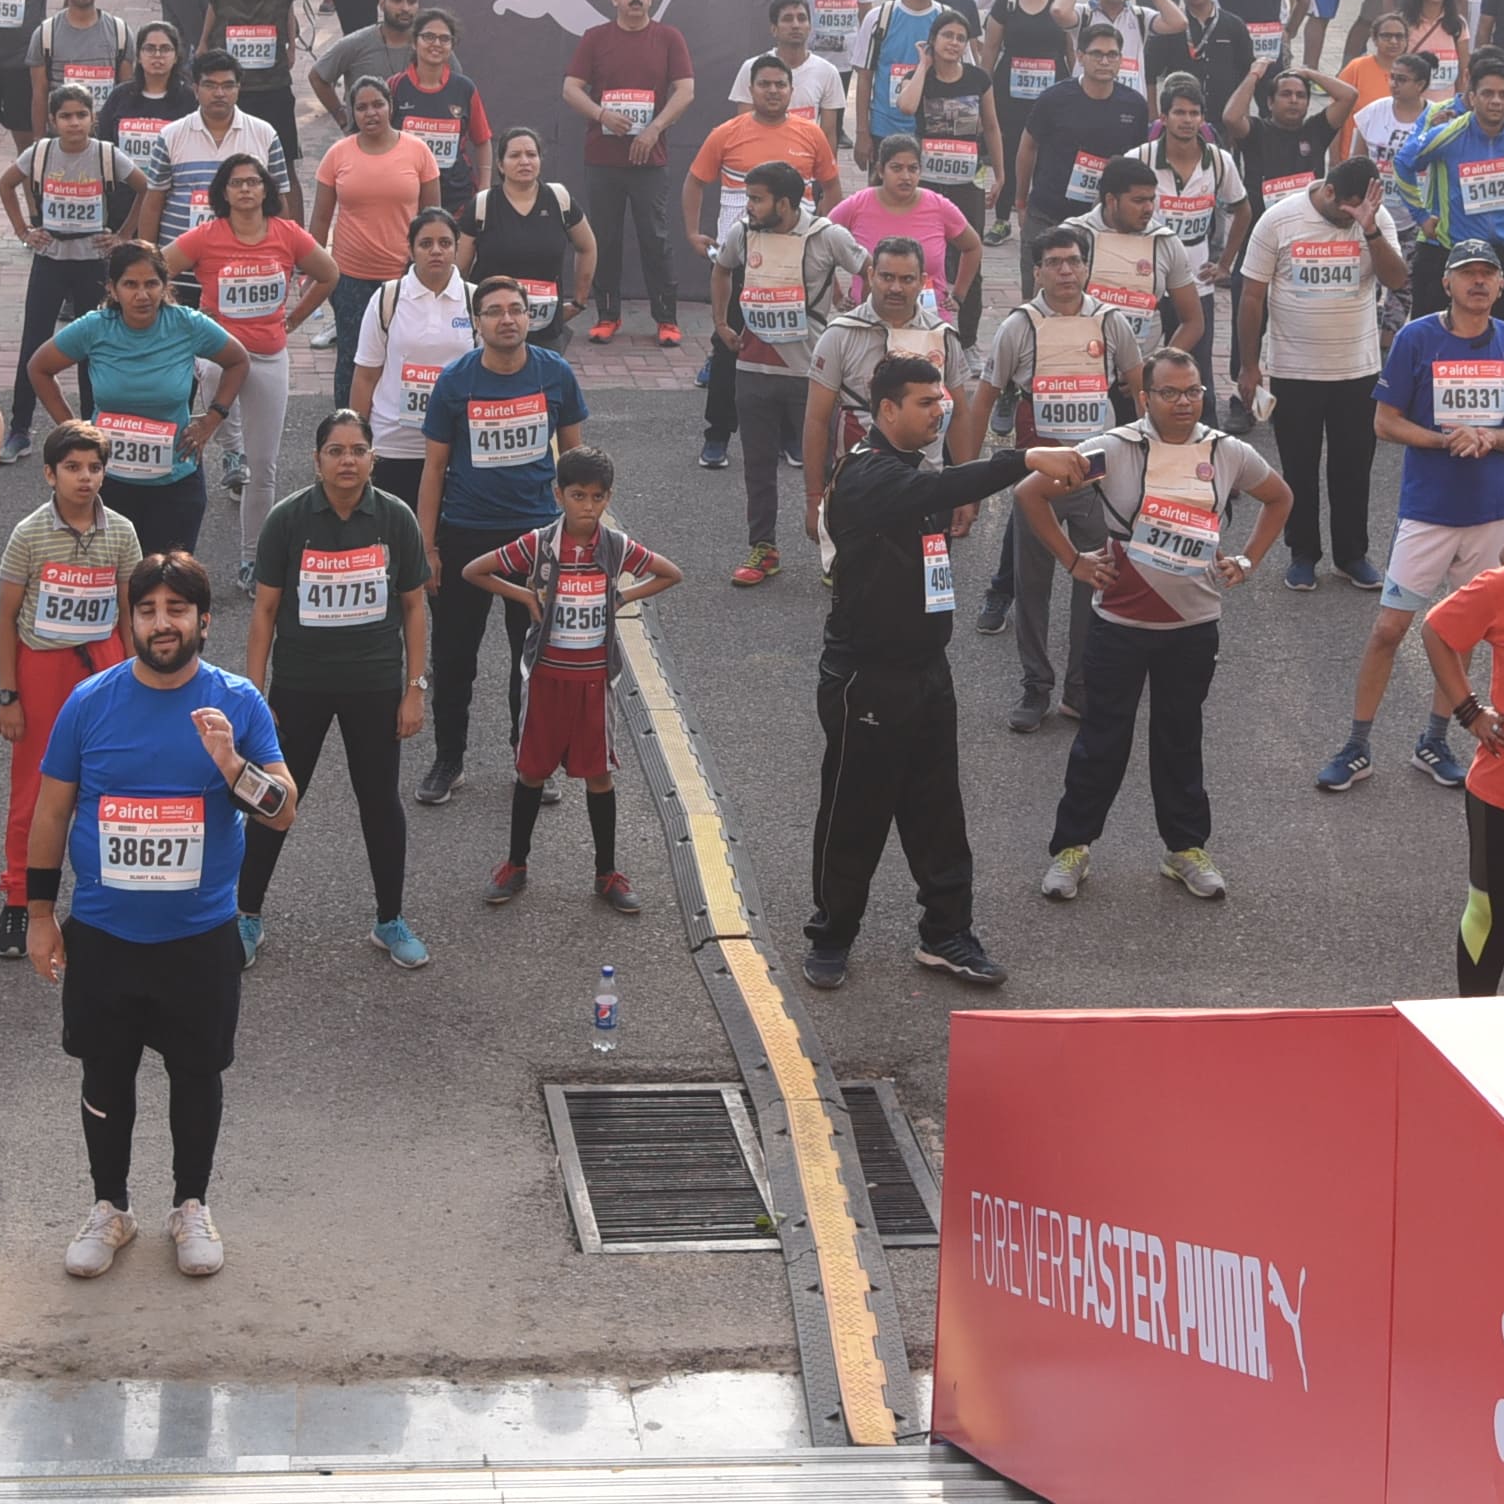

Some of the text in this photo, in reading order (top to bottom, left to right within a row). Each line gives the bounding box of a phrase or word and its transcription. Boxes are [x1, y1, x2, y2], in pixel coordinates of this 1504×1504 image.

[131, 120, 154, 131] airtel
[415, 120, 438, 130] airtel
[932, 141, 955, 152] airtel
[926, 159, 969, 175] 40505
[1472, 161, 1496, 173] airtel
[56, 183, 77, 195] airtel
[1269, 176, 1296, 193] airtel
[48, 203, 94, 220] 41222
[1170, 198, 1194, 209] airtel
[1165, 215, 1208, 234] 57203
[1305, 244, 1331, 257] airtel
[233, 263, 261, 276] airtel
[1299, 266, 1352, 285] 40344
[225, 283, 279, 304] 41699
[751, 289, 776, 302] airtel
[1101, 287, 1128, 306] airtel
[748, 310, 799, 329] 49019
[1448, 363, 1479, 377] airtel
[1047, 377, 1078, 391] airtel
[1441, 387, 1502, 410] 46331
[483, 403, 515, 418] airtel
[1041, 401, 1100, 424] 49080
[111, 415, 143, 432] airtel
[477, 425, 539, 452] 41597
[1158, 503, 1190, 523] airtel
[1146, 527, 1205, 558] 37106
[315, 554, 351, 570] airtel
[58, 568, 93, 585] airtel
[307, 581, 377, 608] 41775
[560, 579, 593, 594] airtel
[45, 595, 110, 624] 52497
[118, 802, 159, 820] airtel
[108, 836, 189, 867] 38627
[971, 1191, 1268, 1382] FOREVER FASTER. PUMA
